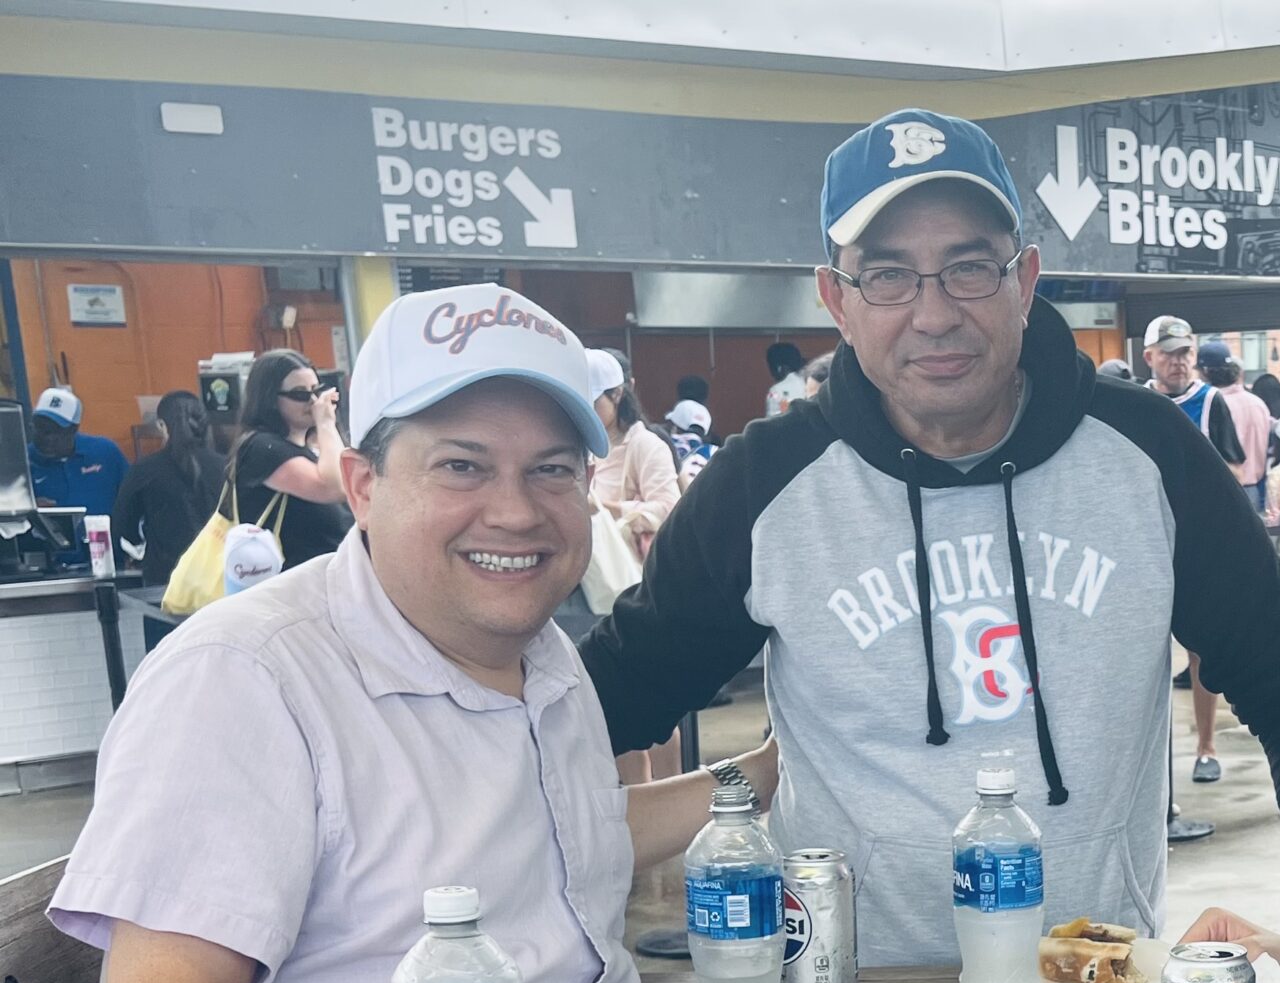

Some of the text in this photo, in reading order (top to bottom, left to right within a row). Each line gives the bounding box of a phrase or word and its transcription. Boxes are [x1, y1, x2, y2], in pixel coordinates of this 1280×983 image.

[371, 107, 562, 162] Burgers
[377, 155, 500, 208] Dogs
[382, 203, 504, 247] Fries
[1108, 189, 1228, 249] Bites
[423, 294, 568, 355] Cyclones
